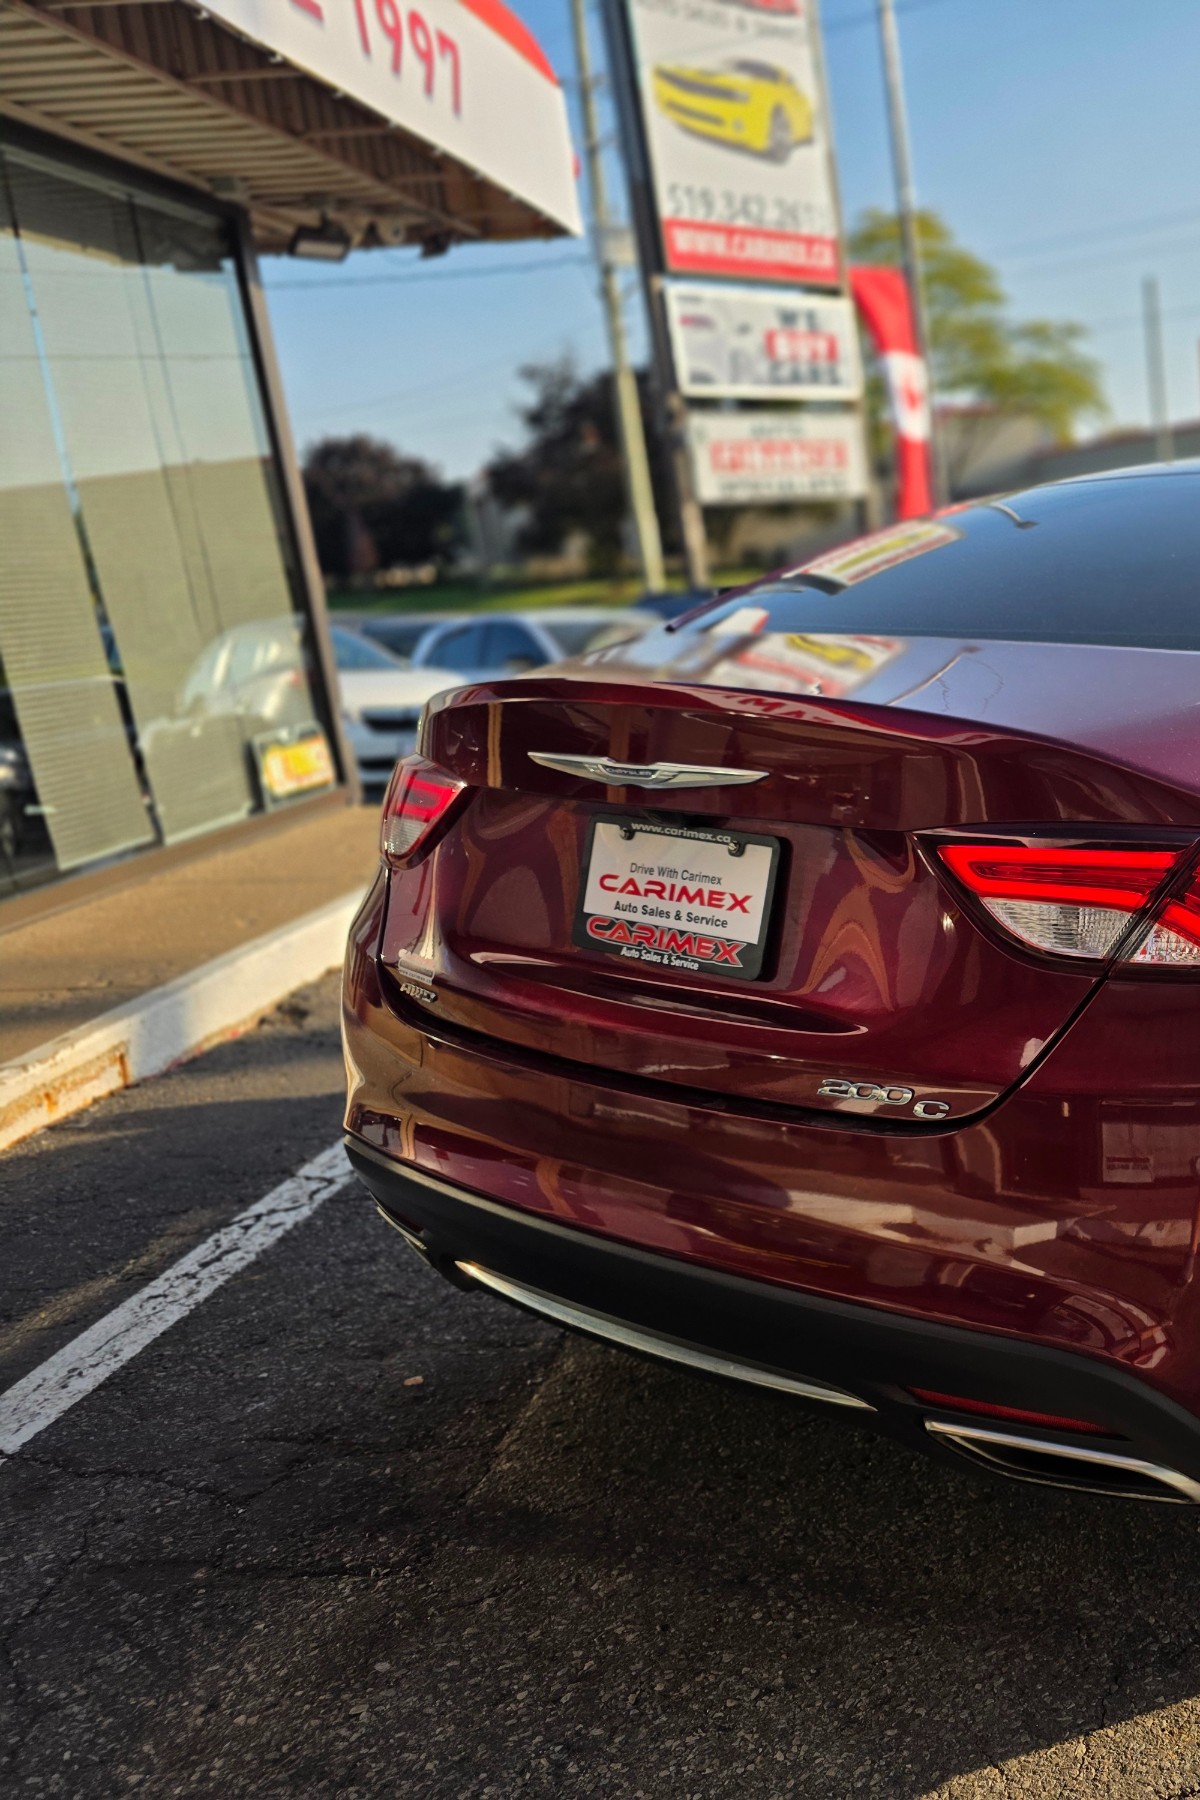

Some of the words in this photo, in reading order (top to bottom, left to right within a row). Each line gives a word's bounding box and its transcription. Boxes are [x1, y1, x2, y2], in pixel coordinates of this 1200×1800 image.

[352, 0, 461, 117] 1997
[631, 822, 732, 843] www.carimex.ca
[630, 862, 655, 876] Drive
[657, 866, 679, 879] With
[681, 869, 722, 885] Carimex
[599, 873, 753, 914] CARIMEX
[614, 901, 638, 914] Auto
[642, 904, 670, 919] Sales
[674, 910, 682, 921] &
[686, 911, 728, 928] Service
[587, 916, 747, 967] CARIMEX
[620, 947, 640, 960] Auto
[641, 950, 661, 963] Sales
[663, 955, 669, 964] &
[670, 956, 699, 970] Service
